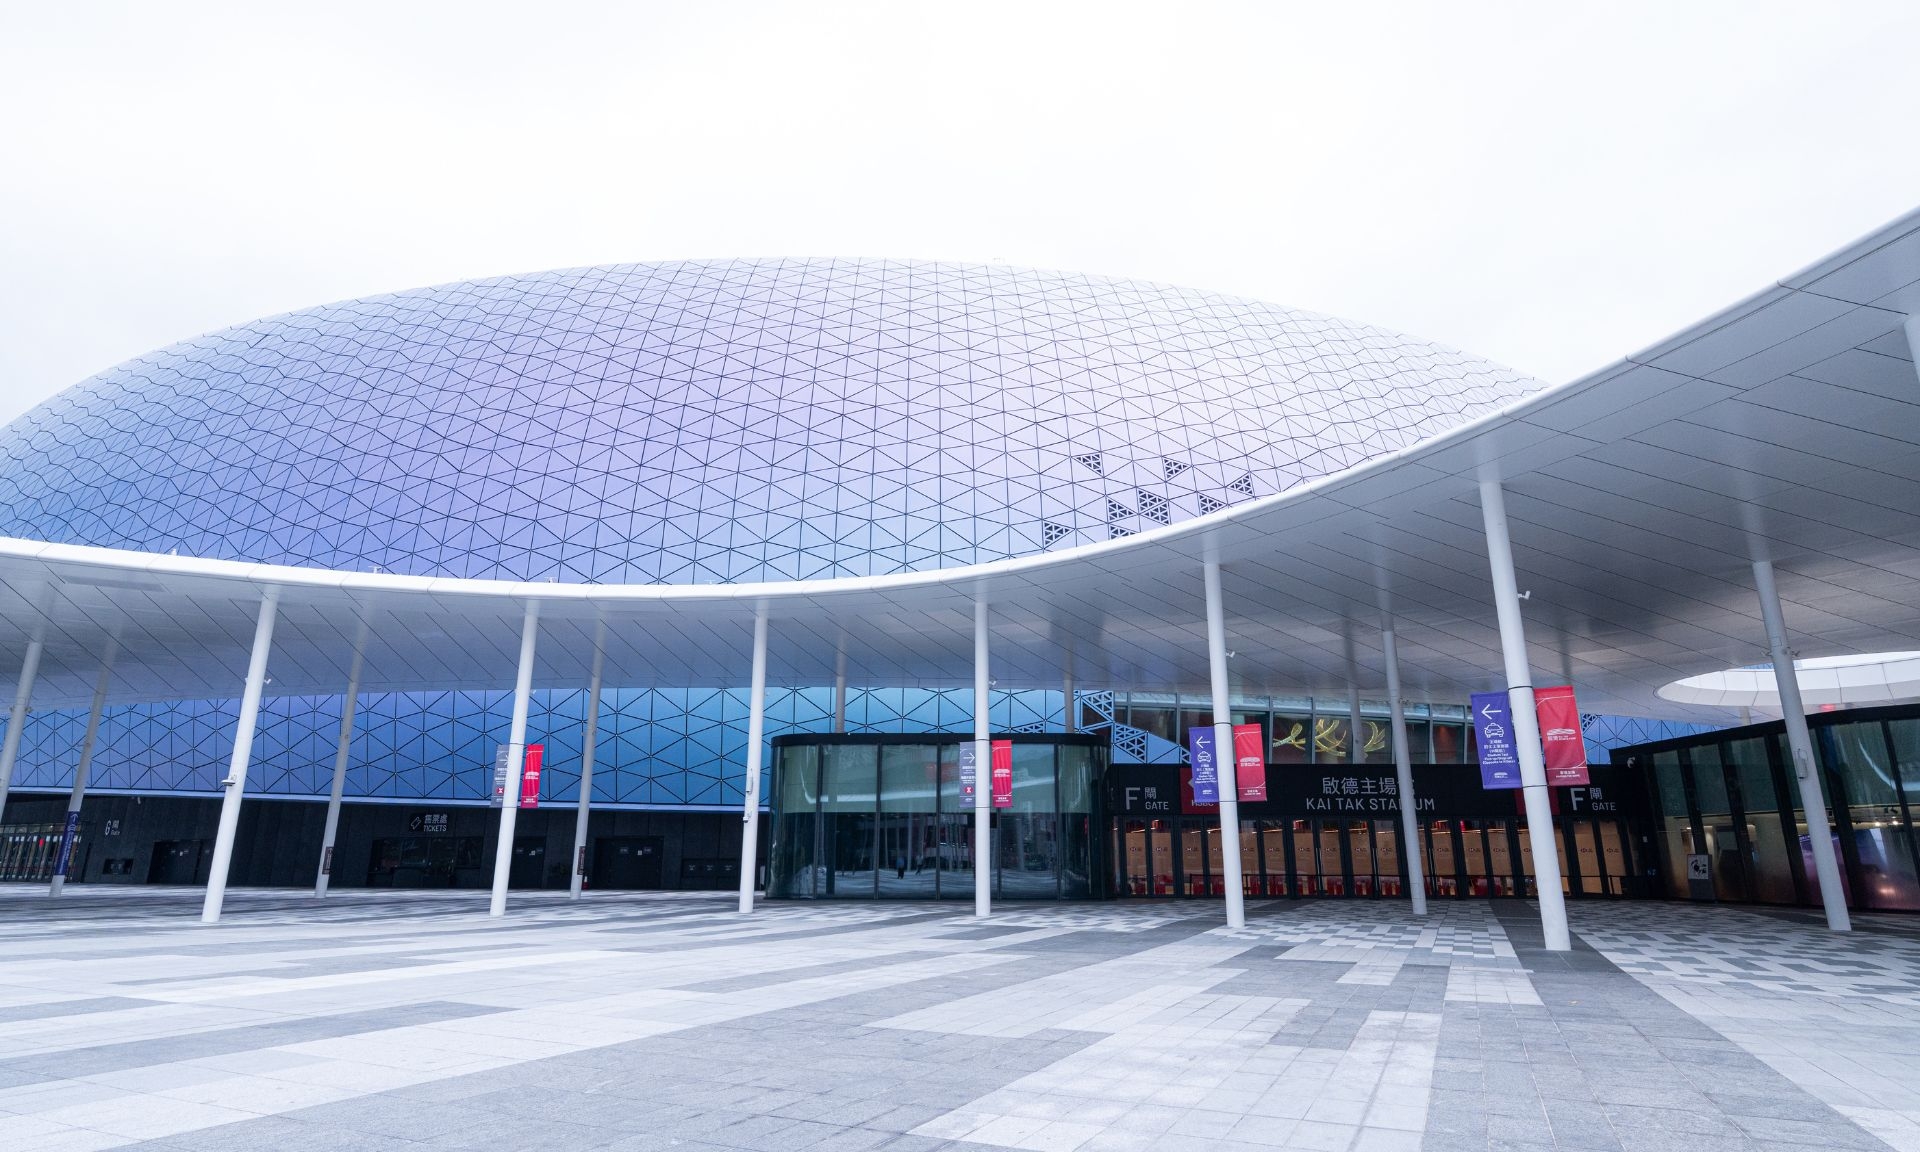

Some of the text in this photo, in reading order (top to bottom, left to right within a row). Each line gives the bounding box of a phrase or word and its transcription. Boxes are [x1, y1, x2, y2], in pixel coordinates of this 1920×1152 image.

[1322, 777, 1415, 795] 啟德主場
[1125, 787, 1157, 810] F 閘
[1306, 798, 1435, 811] KAI TAK STAUM
[1570, 787, 1586, 811] F
[1145, 801, 1169, 810] GATE
[1592, 802, 1617, 811] GATE
[423, 824, 447, 832] TICKETS
